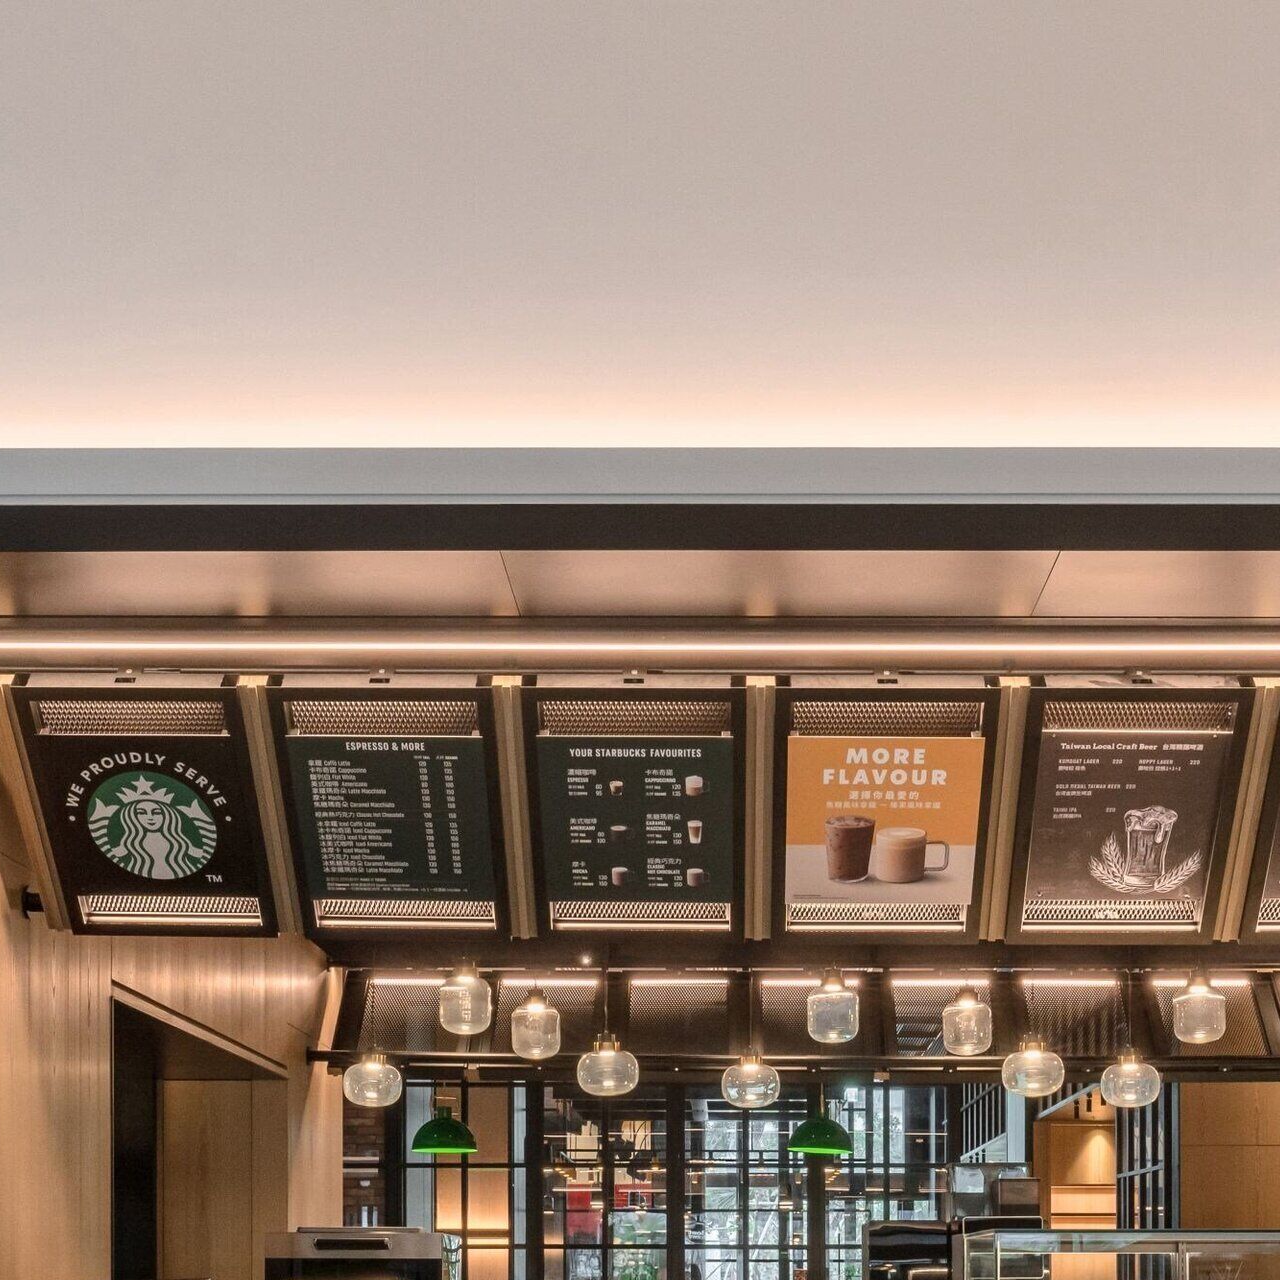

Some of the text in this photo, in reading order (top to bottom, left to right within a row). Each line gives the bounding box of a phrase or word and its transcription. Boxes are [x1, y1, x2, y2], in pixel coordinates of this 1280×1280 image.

[346, 742, 425, 751] ESPRESSO & MORE
[570, 748, 702, 758] YOUR STARBUCKS FAVOURITES
[846, 748, 926, 764] MORE
[66, 752, 228, 808] WE PROUDLY SERVE
[823, 769, 947, 785] FLAVOUR
[206, 874, 223, 883] TM
